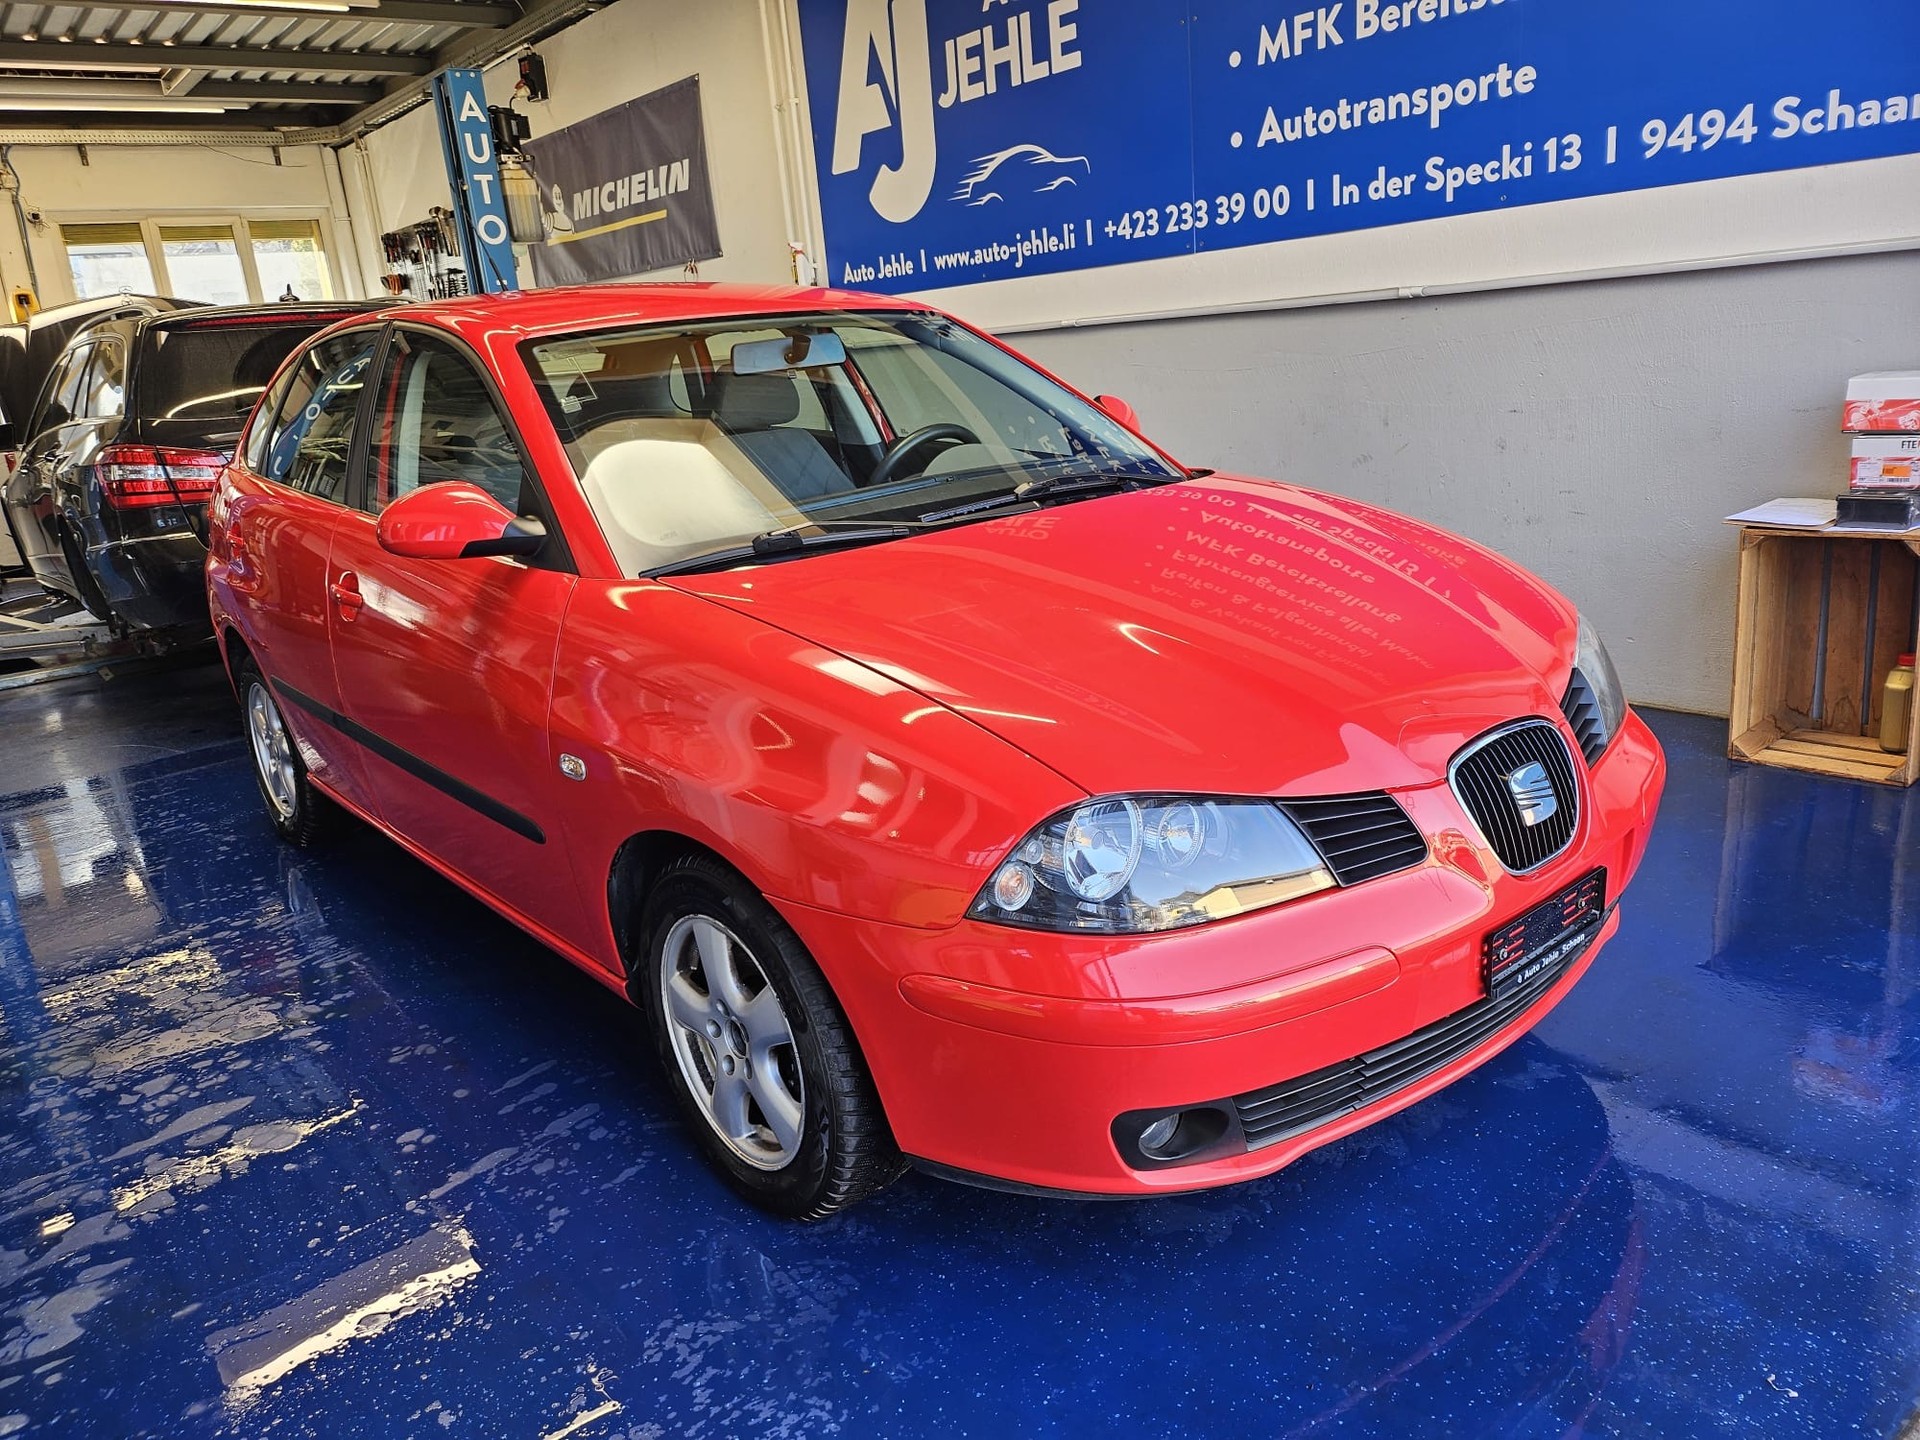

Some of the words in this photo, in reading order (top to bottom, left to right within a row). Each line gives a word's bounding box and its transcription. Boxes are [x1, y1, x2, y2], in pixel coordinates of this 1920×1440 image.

[938, 0, 1082, 108] JEHLE
[1257, 2, 1344, 66] MFK
[832, 0, 937, 223] AJ
[1257, 63, 1537, 148] Autotransporte
[459, 90, 508, 246] AUTO
[573, 158, 690, 221] MICHELIN
[843, 262, 875, 284] Auto
[878, 252, 913, 279] Jehle
[933, 223, 1076, 268] www.auto-jehle.li
[1104, 208, 1160, 240] +423
[1165, 199, 1209, 234] 233
[1215, 193, 1246, 226] 39
[1253, 184, 1290, 219] 00
[1333, 174, 1360, 206] In
[1367, 166, 1416, 201] der
[1424, 141, 1533, 202] Specki
[1543, 133, 1582, 173] 13
[1641, 103, 1758, 159] 9494
[1772, 89, 1920, 138] Schaa
[1524, 963, 1541, 980] Auto
